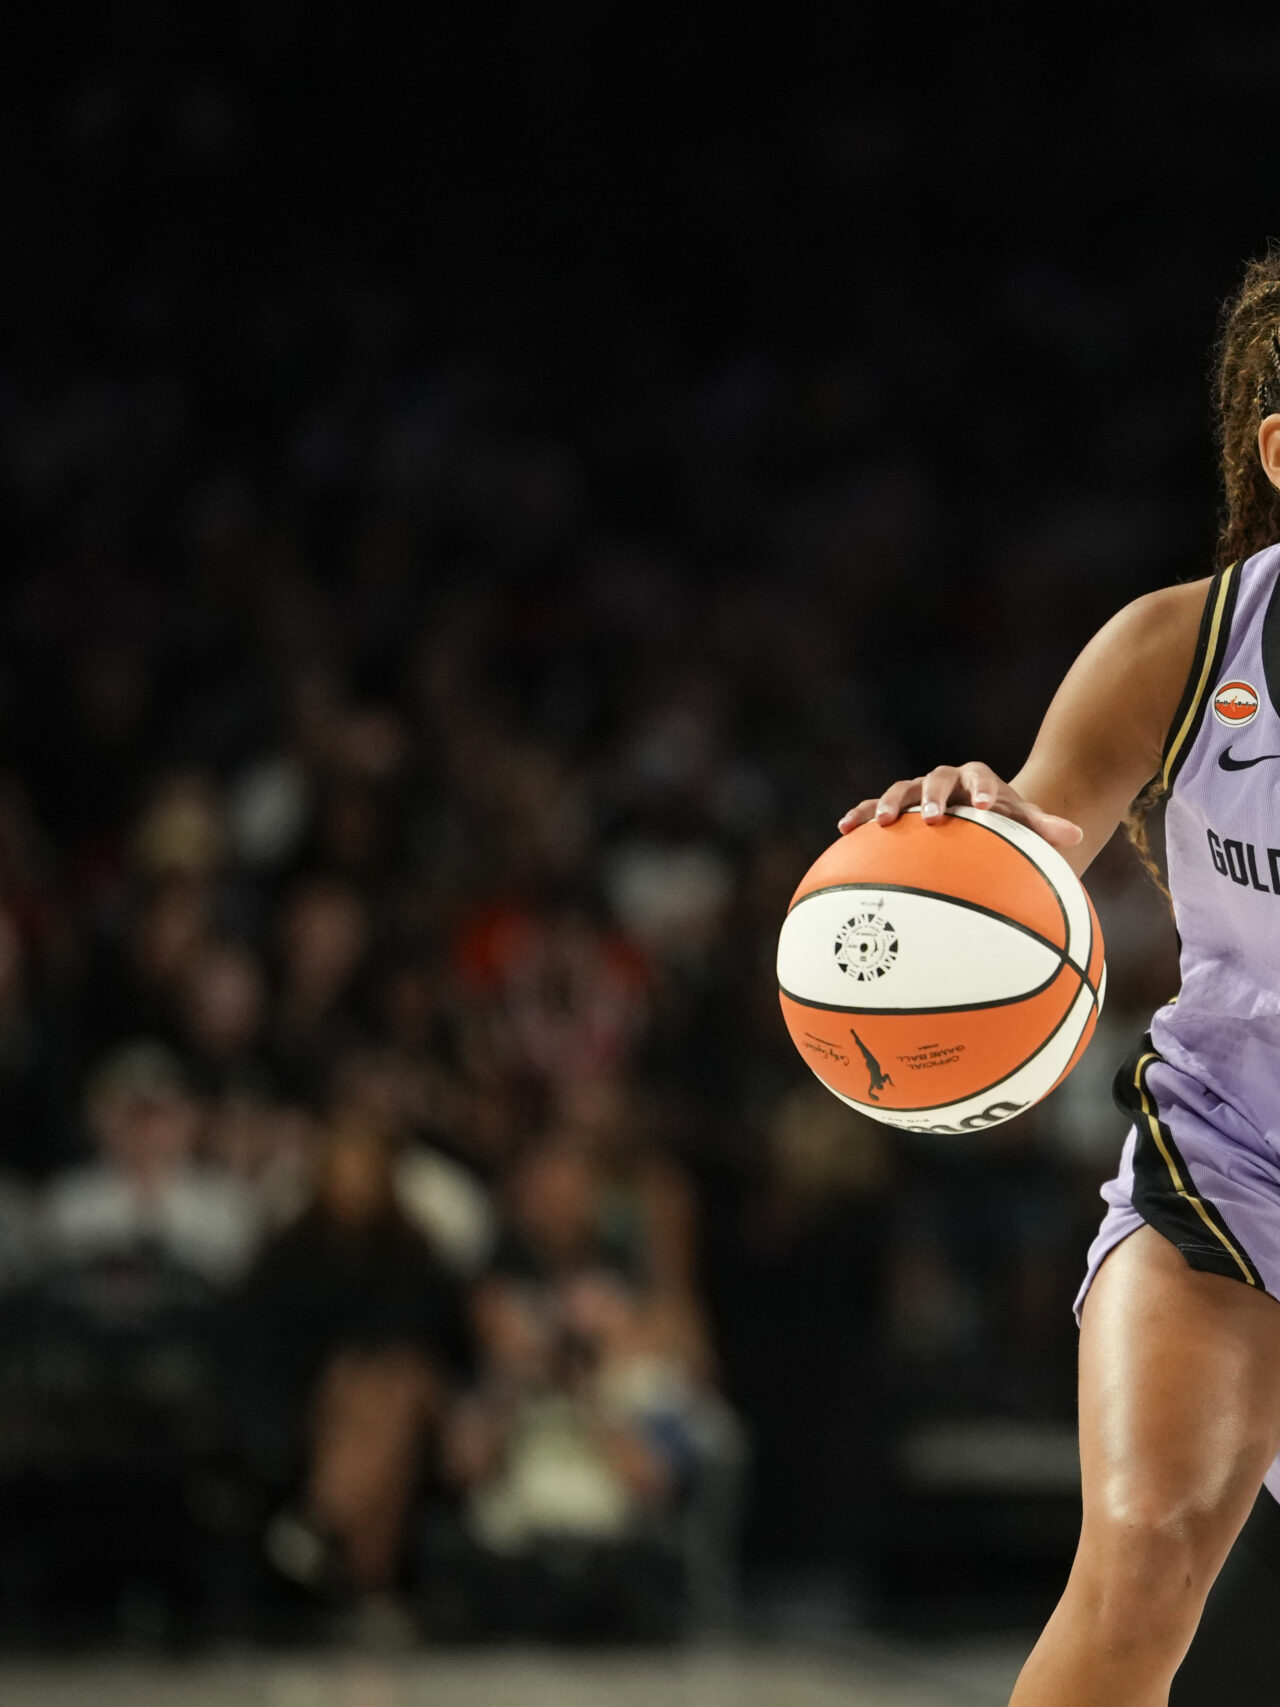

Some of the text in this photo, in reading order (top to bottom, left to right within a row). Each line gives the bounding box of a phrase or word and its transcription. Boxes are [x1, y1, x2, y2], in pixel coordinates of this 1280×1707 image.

[896, 1053, 928, 1064] BALL
[928, 1044, 965, 1059] GAME
[906, 1055, 960, 1070] OFFICIAL
